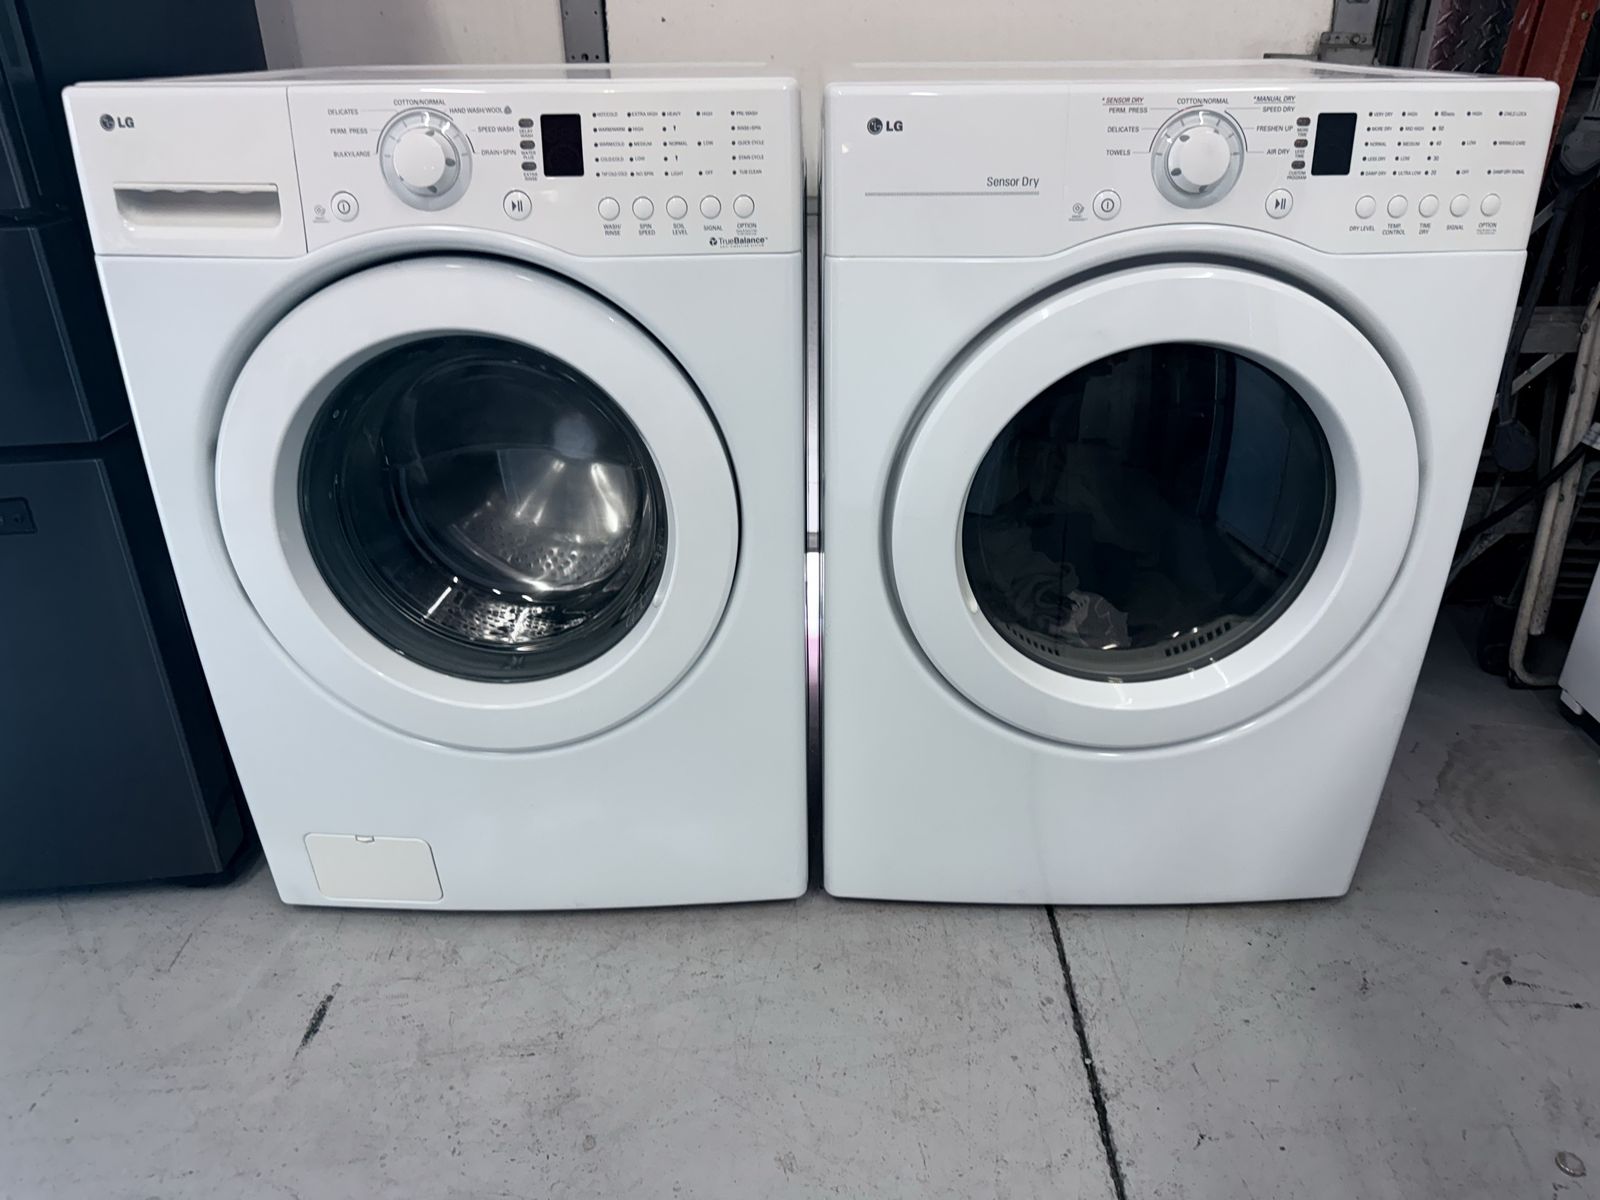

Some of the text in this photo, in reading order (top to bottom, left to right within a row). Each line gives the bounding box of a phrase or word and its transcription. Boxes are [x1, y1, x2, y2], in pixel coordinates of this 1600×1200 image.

[393, 98, 445, 106] COTTON/NORMAL
[117, 116, 135, 129] LG
[886, 121, 903, 132] LG
[987, 176, 1039, 188] Sensor Dry
